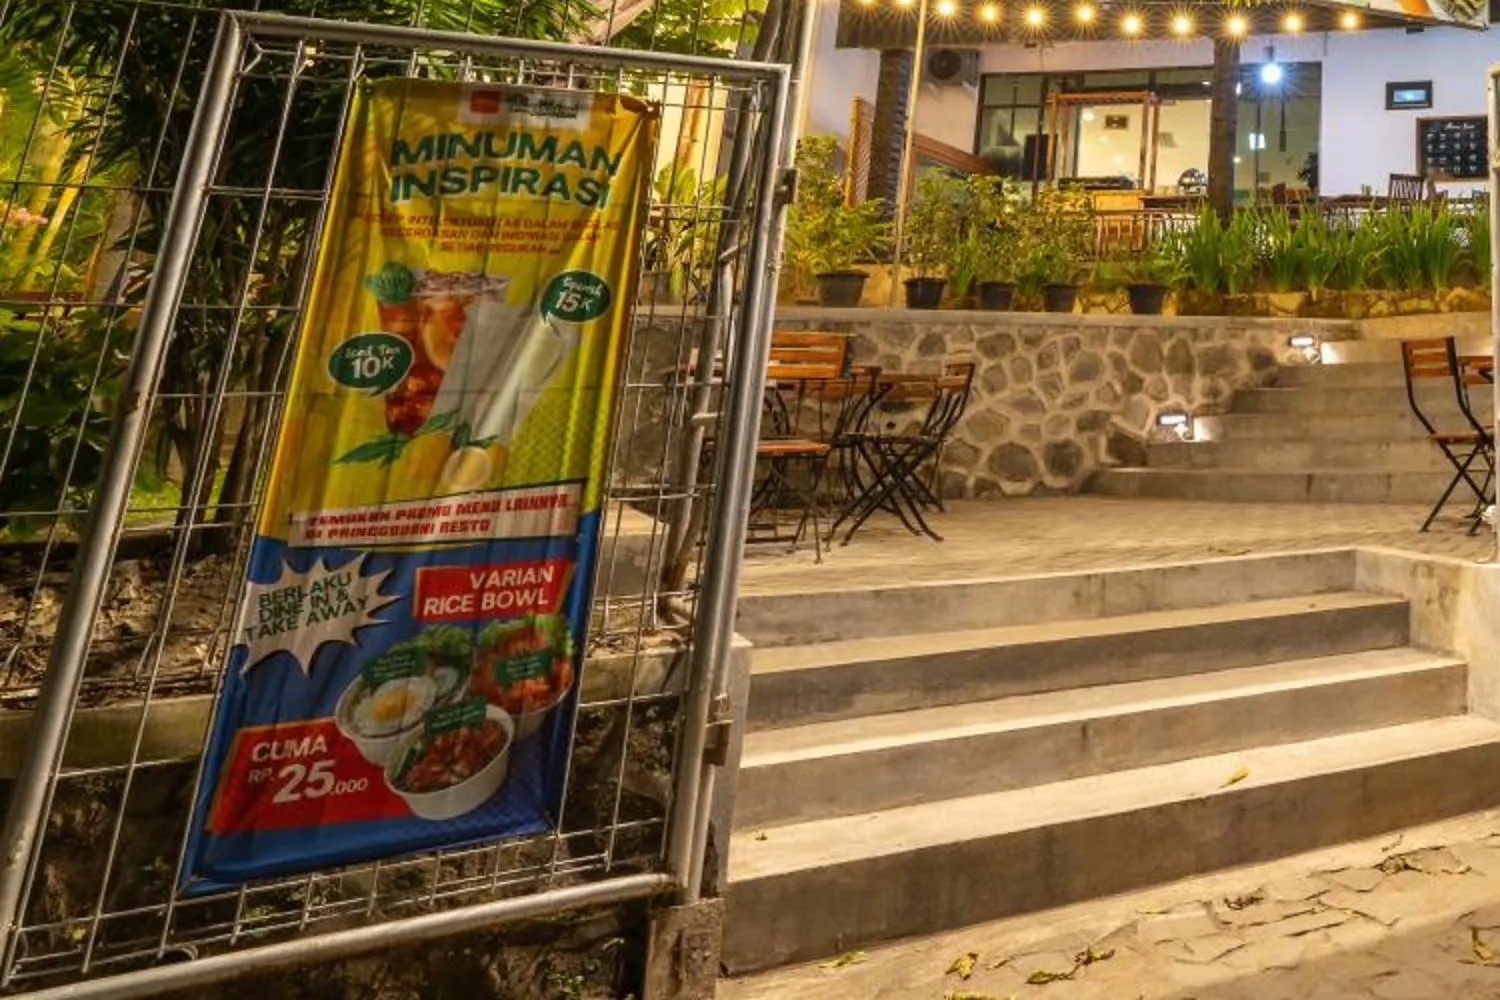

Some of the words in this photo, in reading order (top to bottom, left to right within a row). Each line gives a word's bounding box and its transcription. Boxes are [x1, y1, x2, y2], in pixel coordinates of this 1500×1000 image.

[391, 131, 623, 176] MINUMAN
[390, 165, 611, 210] INSPIRASI
[352, 356, 395, 379] 10K
[456, 499, 502, 516] MENU
[440, 519, 491, 533] RESTO
[258, 572, 352, 606] BERLAKU
[470, 565, 555, 590] VARIAN
[258, 601, 304, 624] DINE
[311, 593, 330, 609] IN
[424, 594, 476, 616] RICE
[481, 587, 549, 610] BOWL
[244, 615, 299, 641] TAKE
[305, 596, 369, 626] AWAY
[251, 734, 329, 763] CUMA
